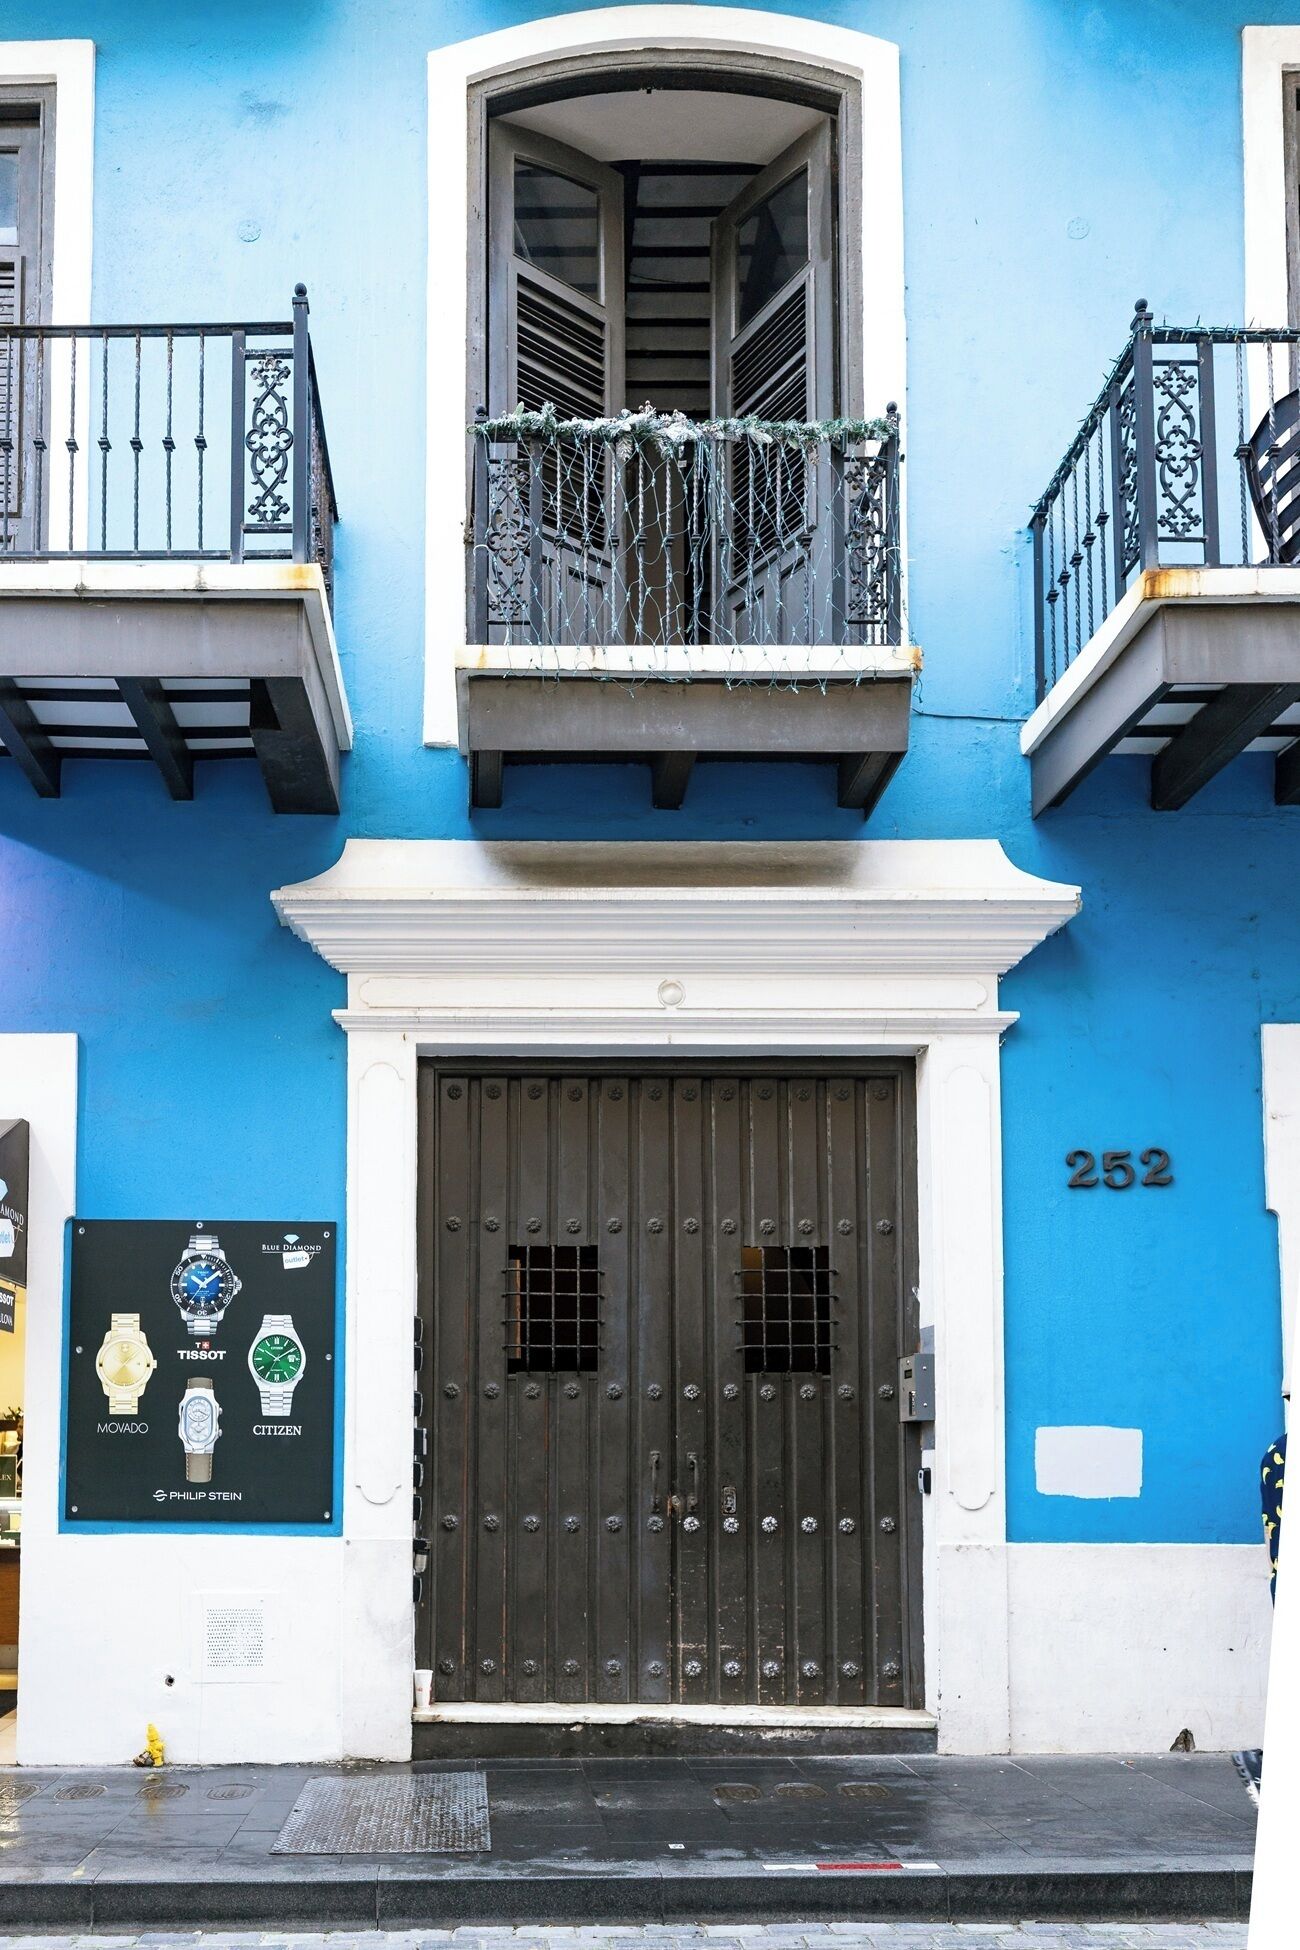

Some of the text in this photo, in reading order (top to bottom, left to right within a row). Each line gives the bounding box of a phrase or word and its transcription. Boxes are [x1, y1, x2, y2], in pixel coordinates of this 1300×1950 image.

[1065, 1147, 1174, 1190] 252
[284, 1256, 305, 1264] outlet
[177, 1350, 226, 1360] TISSOT
[97, 1422, 148, 1434] MOVADO
[252, 1425, 302, 1436] CITIZEN
[169, 1491, 242, 1501] PHILIP STEIN
